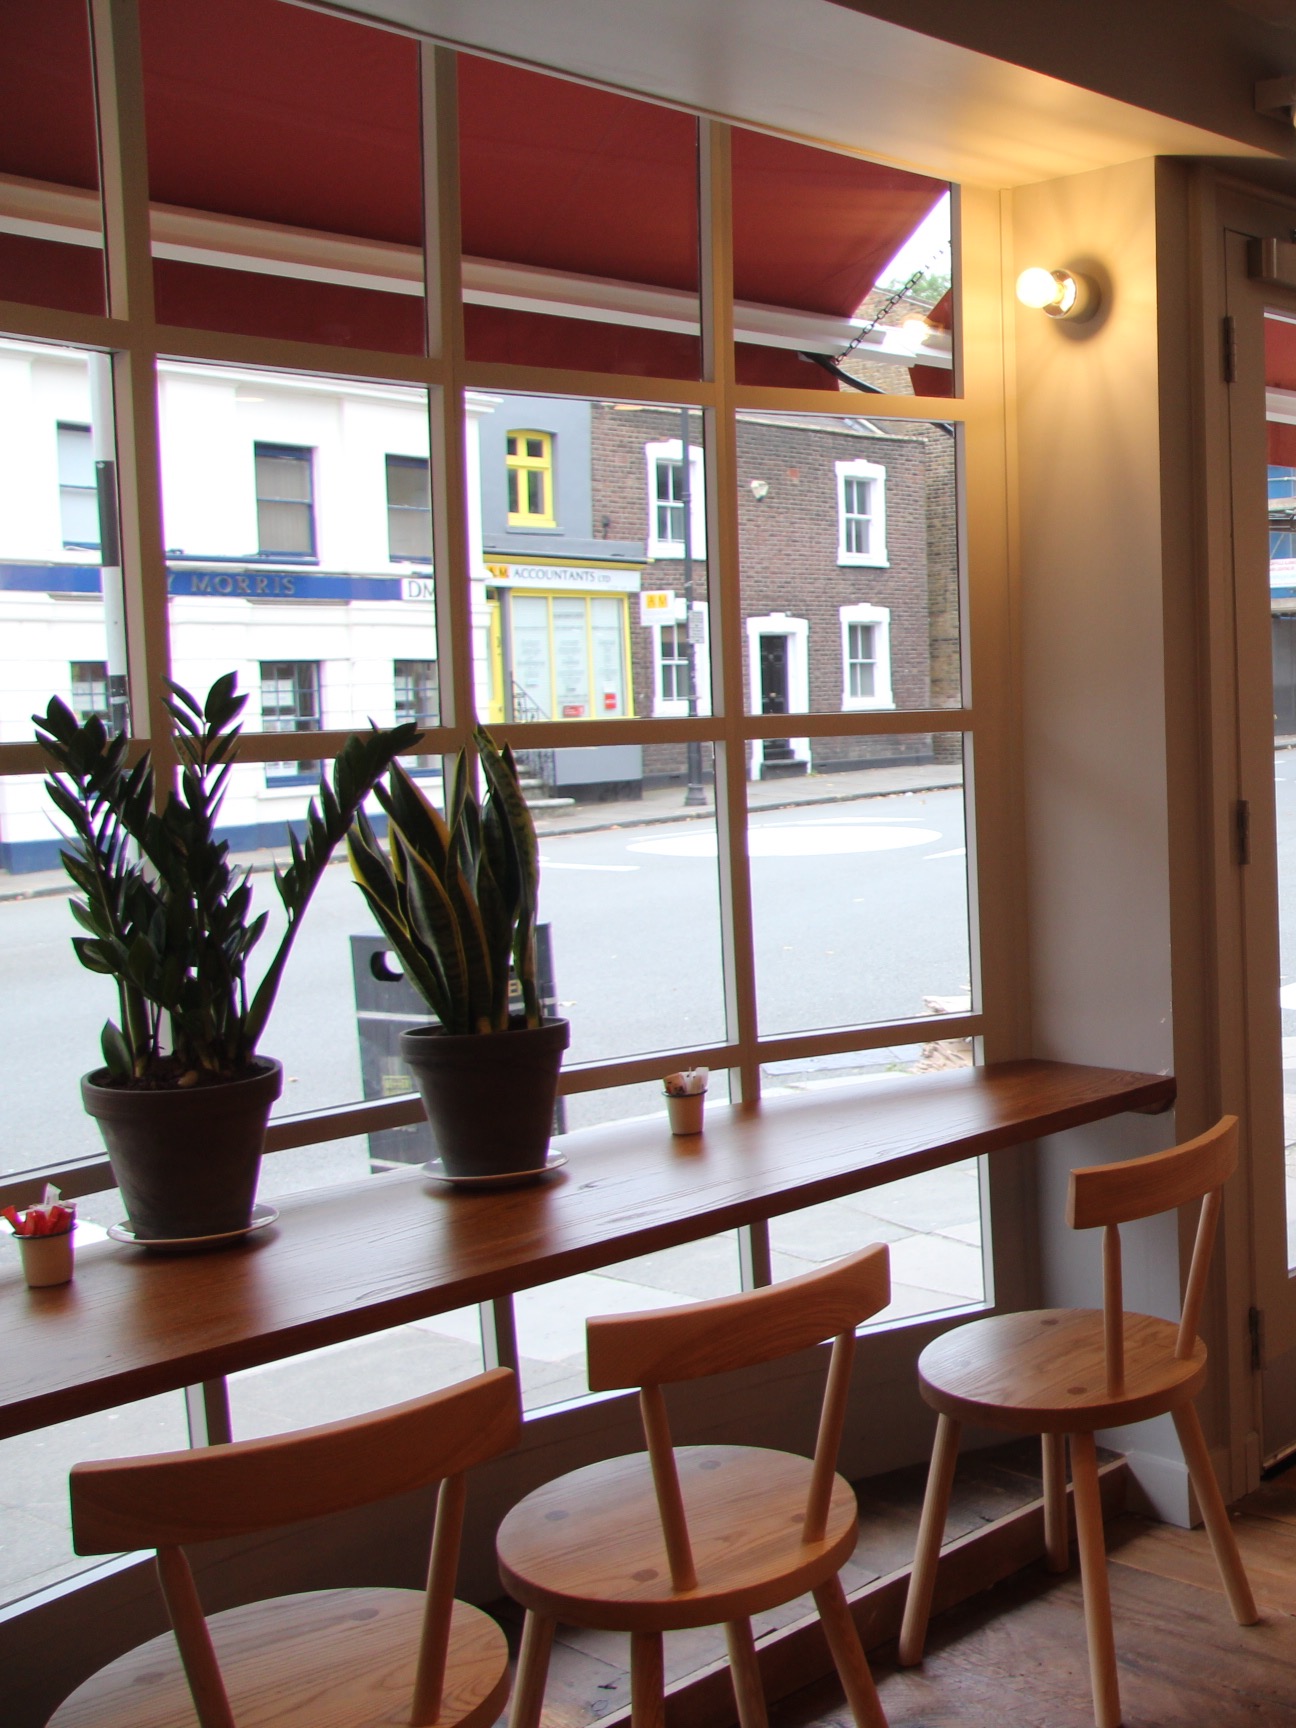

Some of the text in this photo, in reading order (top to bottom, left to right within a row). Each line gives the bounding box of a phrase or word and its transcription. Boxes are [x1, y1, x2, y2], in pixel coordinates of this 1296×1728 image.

[191, 574, 296, 595] MORRIS
[514, 568, 595, 583] ACCOUNTANTS
[597, 574, 611, 583] LTD
